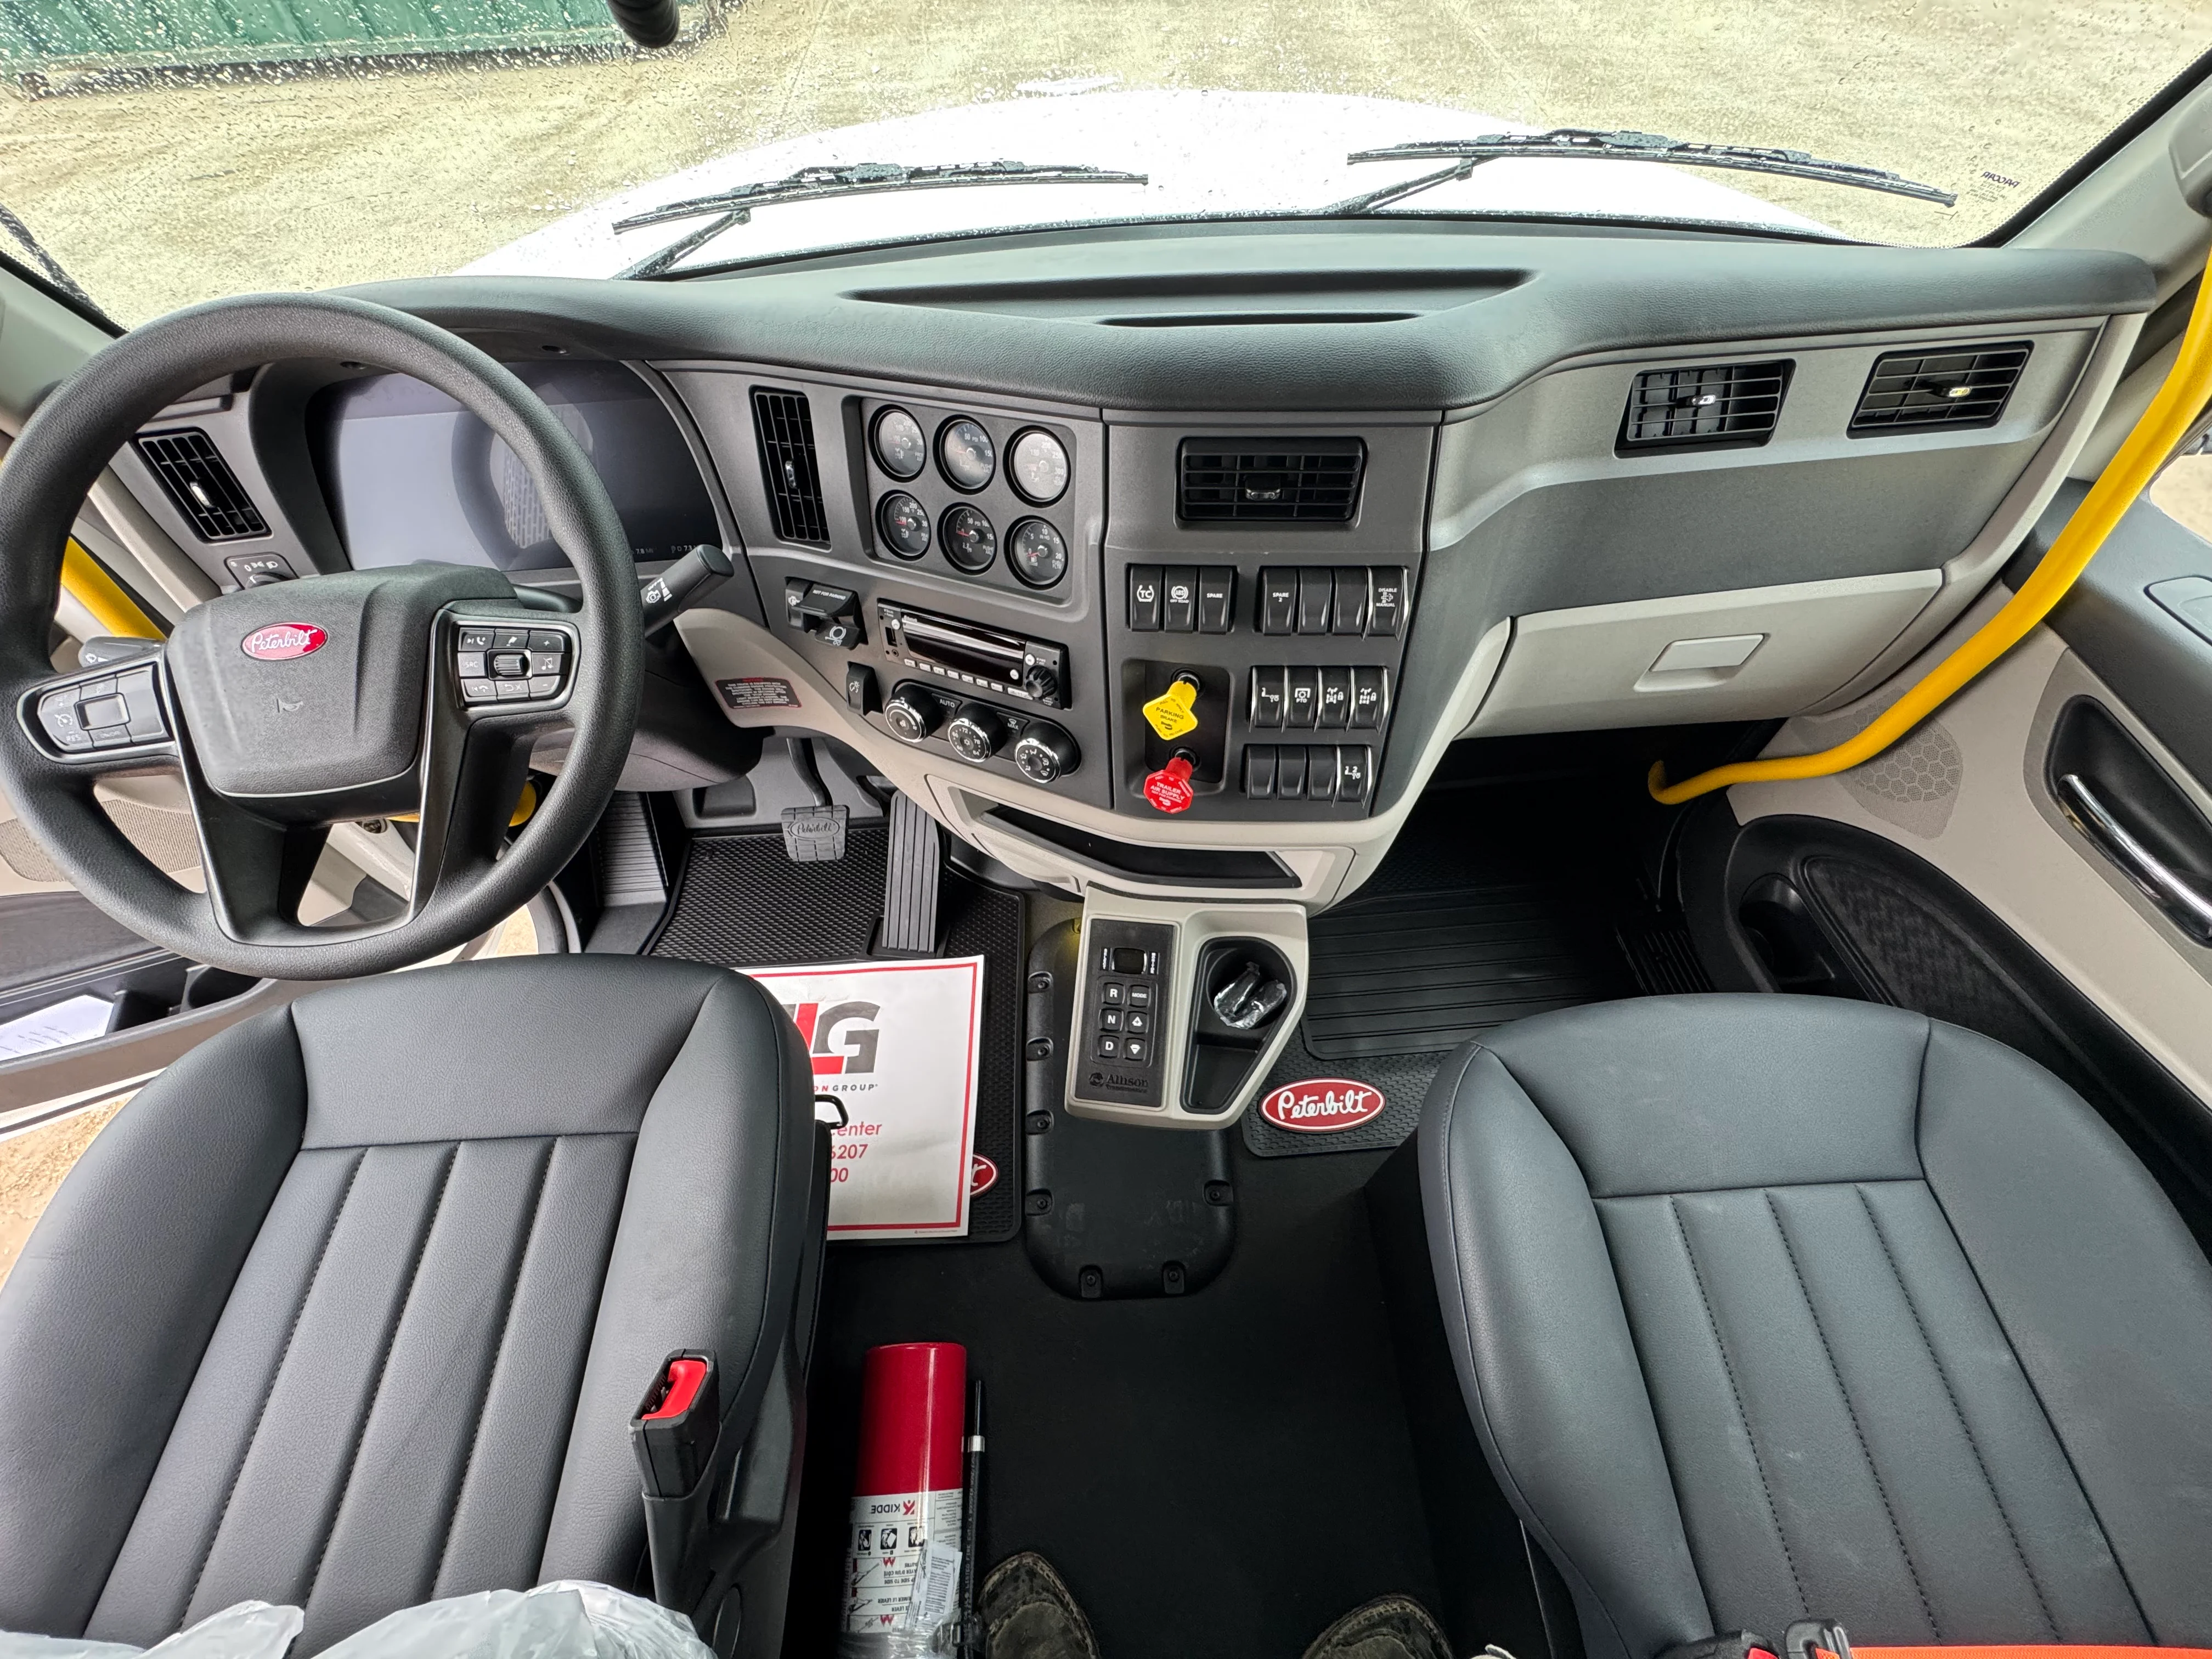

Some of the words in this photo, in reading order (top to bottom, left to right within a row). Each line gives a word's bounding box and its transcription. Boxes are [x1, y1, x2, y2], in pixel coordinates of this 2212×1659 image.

[1140, 590, 1152, 599] TC
[251, 629, 318, 653] Peterbilt
[940, 698, 955, 708] AUTO
[1156, 706, 1184, 720] PARKING
[1160, 714, 1177, 724] BRAKE
[1156, 781, 1181, 795] TRAILER
[1161, 789, 1185, 800] SUPPLY
[797, 822, 833, 834] Peterbilt
[1110, 988, 1118, 998] R
[1107, 1015, 1116, 1024] N
[1105, 1041, 1114, 1051] D
[1278, 1090, 1372, 1120] Peterbilt
[831, 1121, 883, 1137] enter
[871, 1503, 901, 1514] KIDDE
